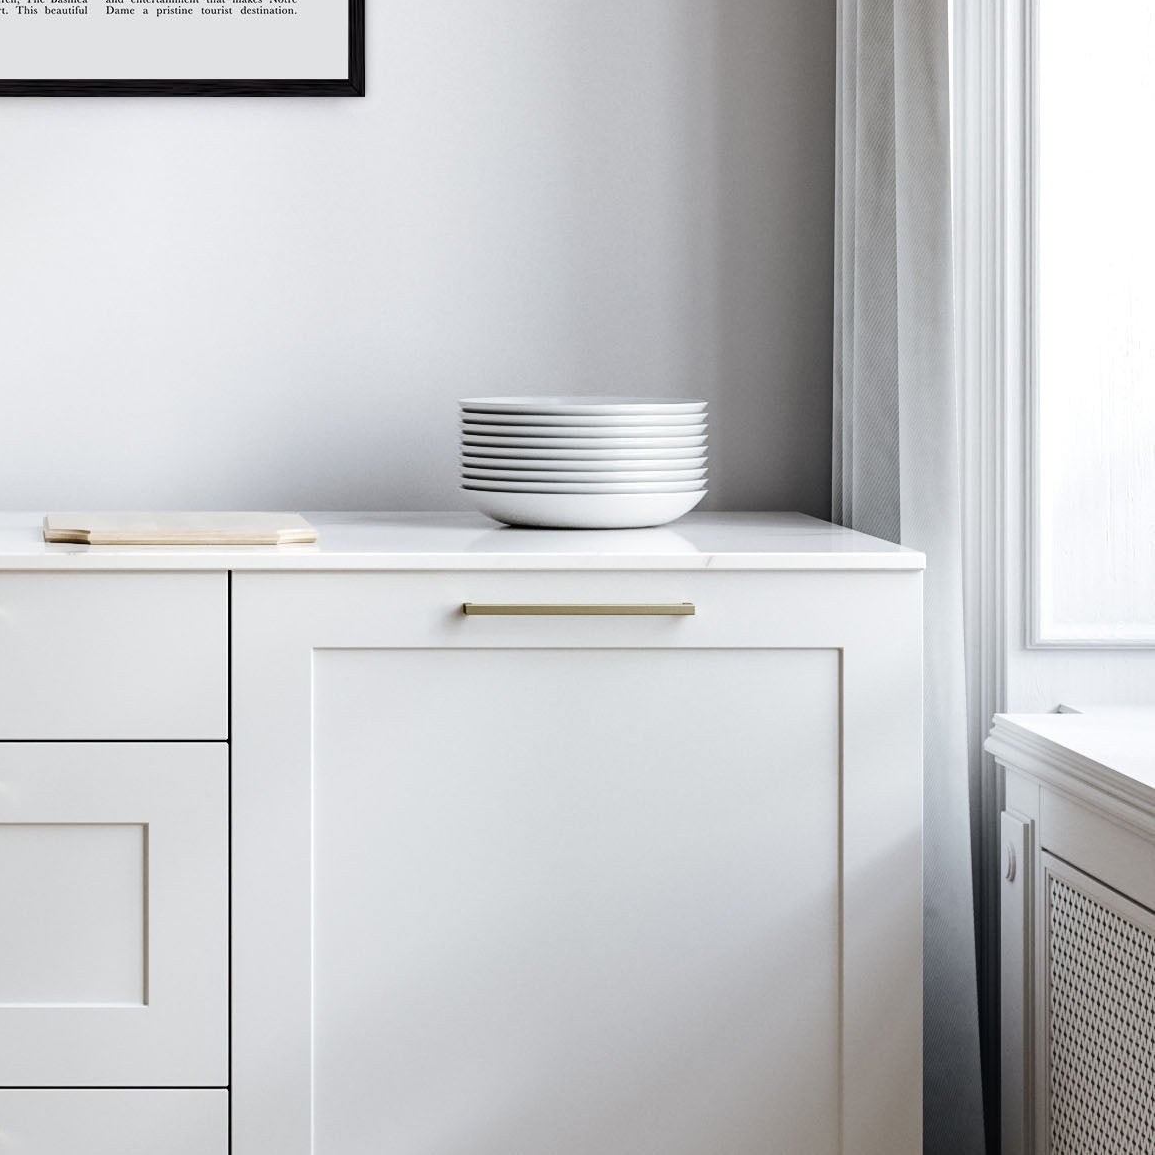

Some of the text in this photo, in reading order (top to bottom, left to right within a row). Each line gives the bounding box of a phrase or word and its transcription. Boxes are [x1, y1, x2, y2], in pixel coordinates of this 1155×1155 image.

[106, 6, 134, 15] Dame
[157, 6, 193, 17] pristine
[201, 6, 232, 15] tourist
[240, 6, 297, 15] destination.
